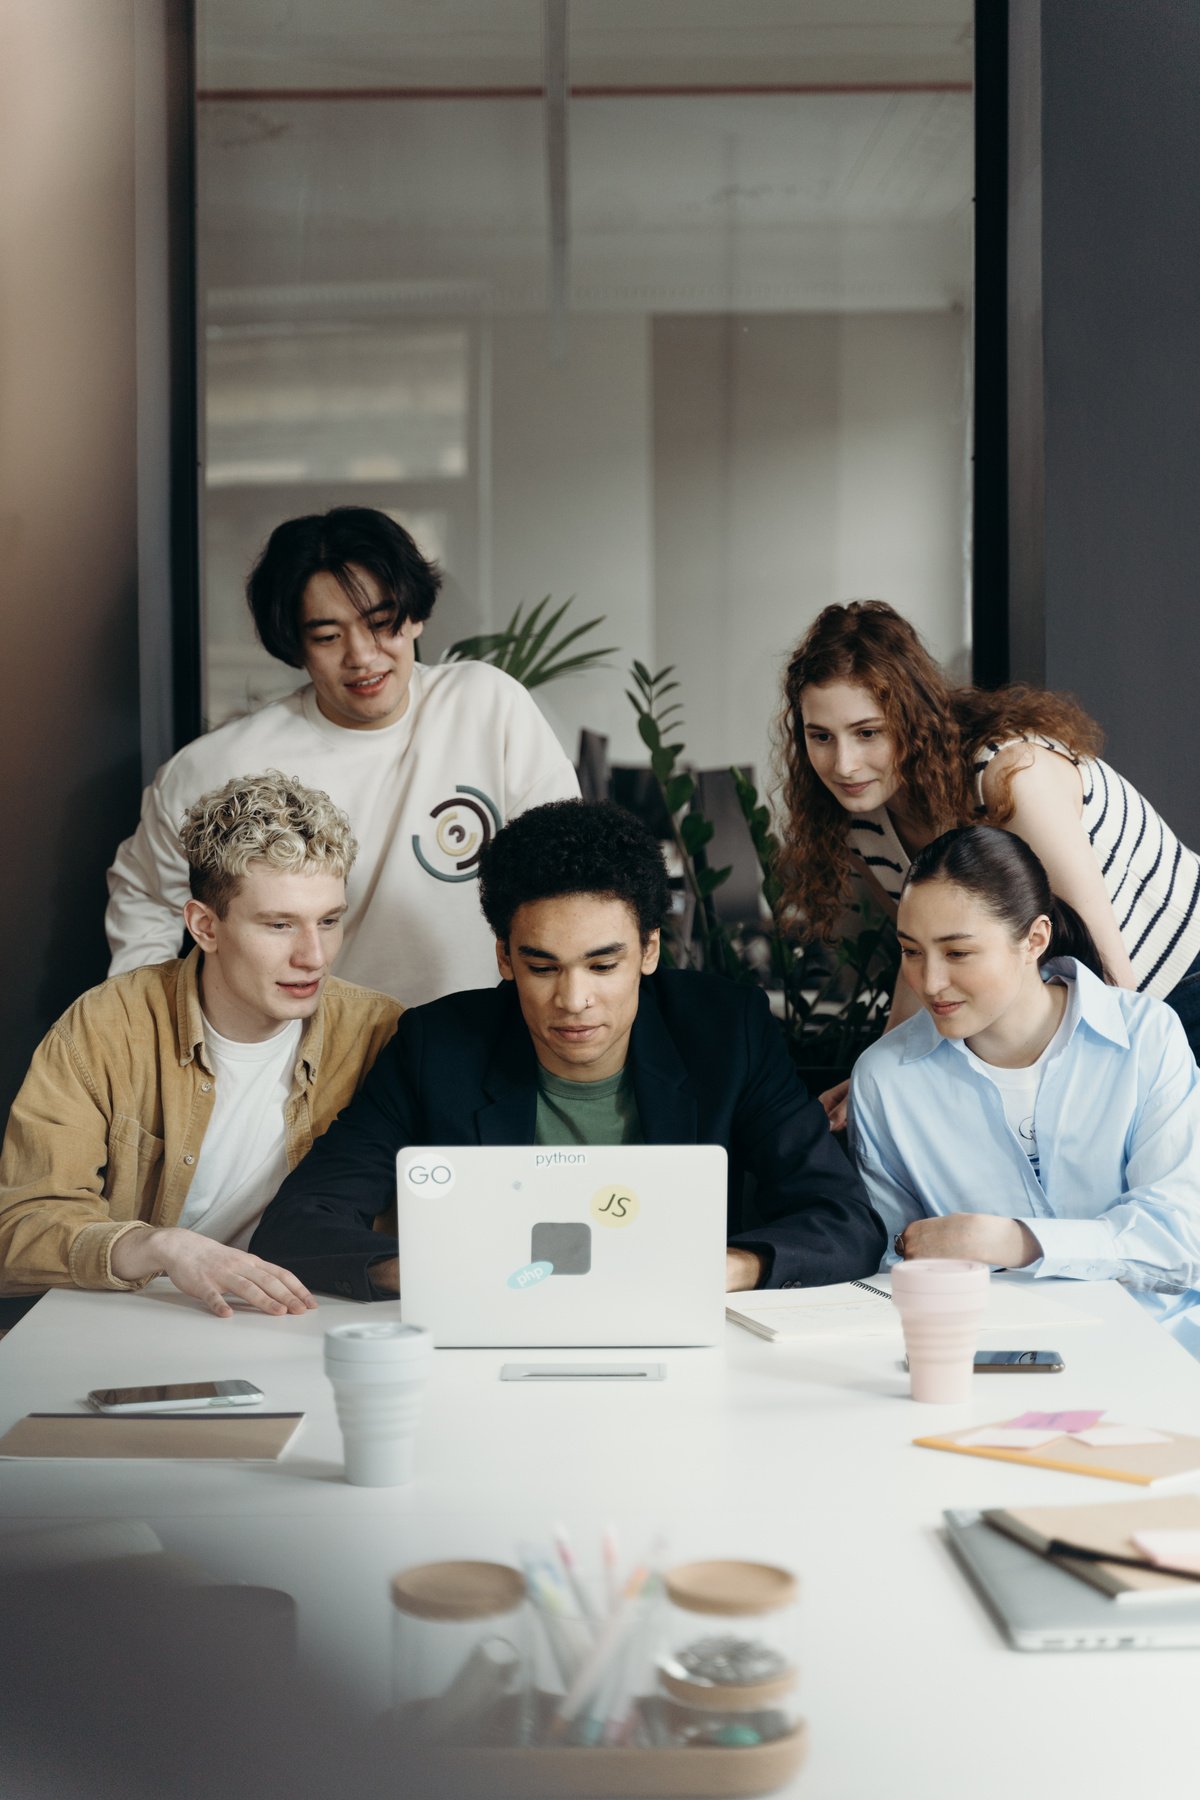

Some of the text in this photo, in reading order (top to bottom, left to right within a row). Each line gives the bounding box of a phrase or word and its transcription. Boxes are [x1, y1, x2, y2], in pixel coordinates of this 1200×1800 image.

[535, 1152, 586, 1167] python
[408, 1165, 451, 1185] GO
[598, 1193, 631, 1218] JS
[516, 1266, 545, 1287] php
